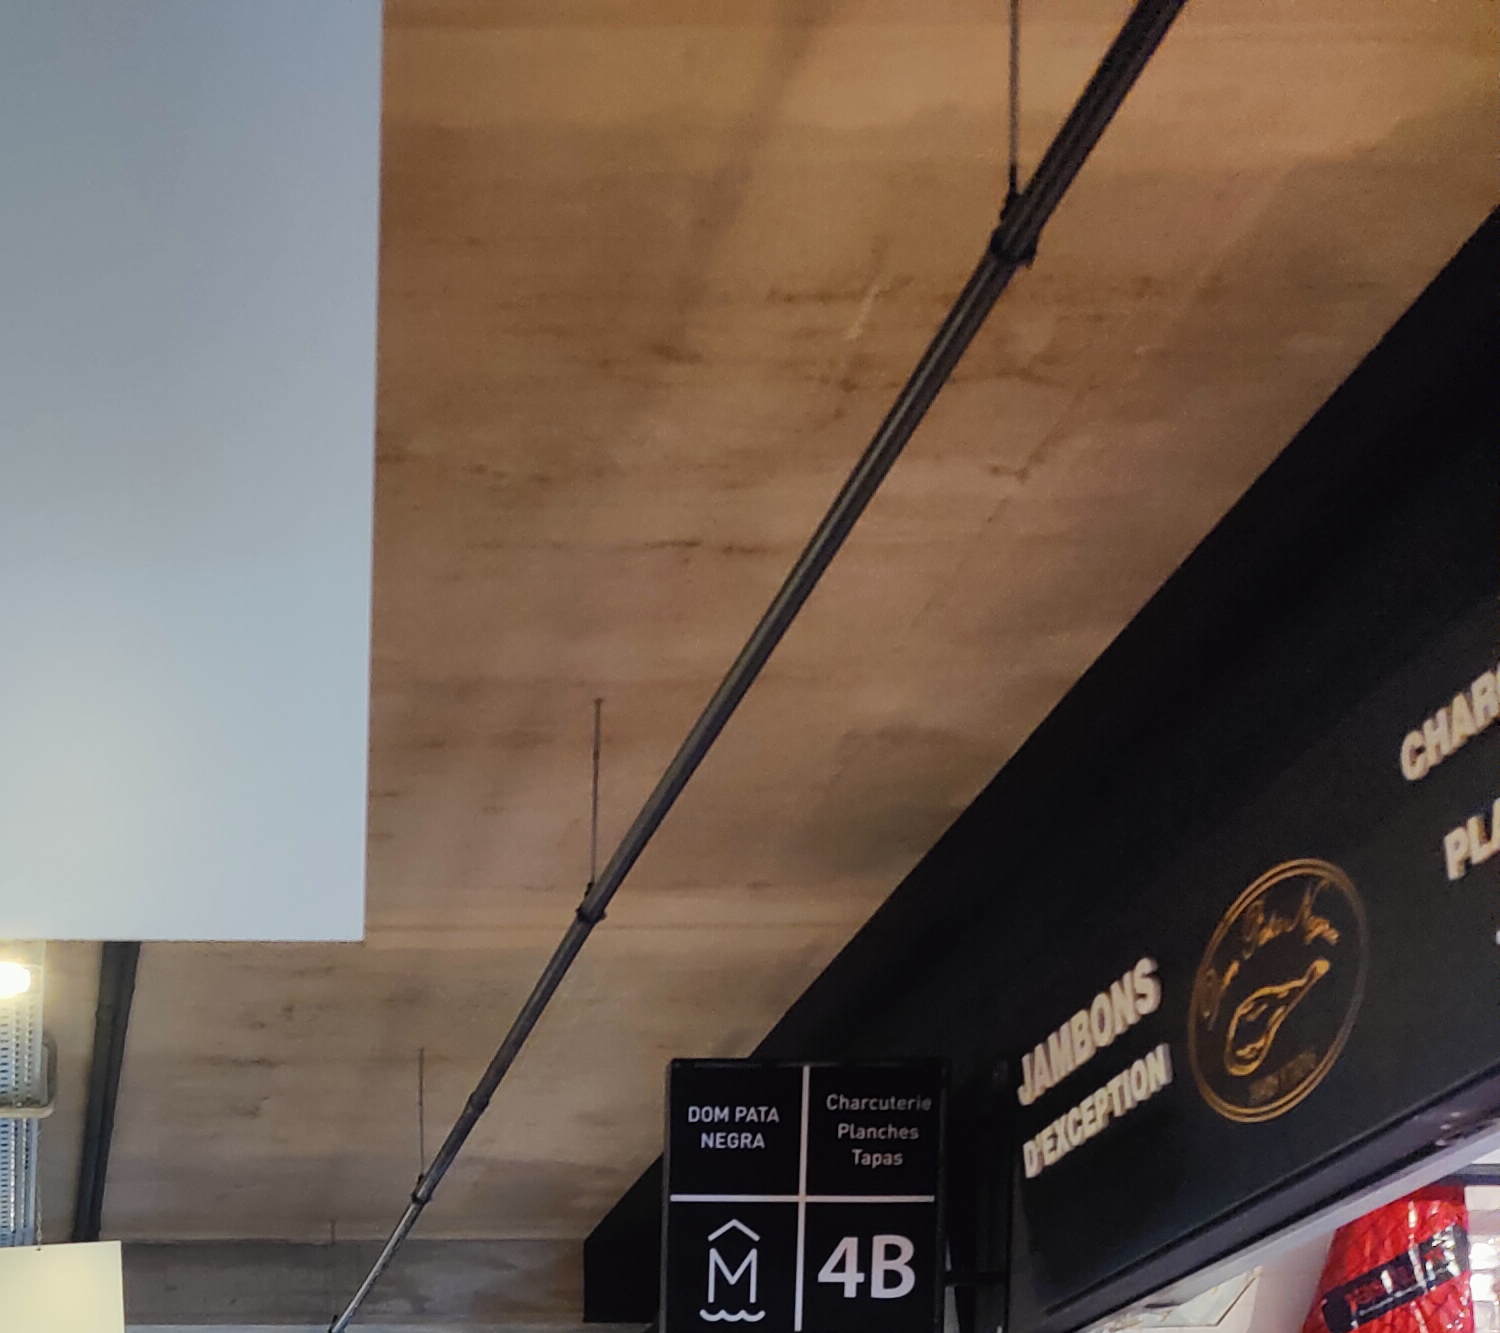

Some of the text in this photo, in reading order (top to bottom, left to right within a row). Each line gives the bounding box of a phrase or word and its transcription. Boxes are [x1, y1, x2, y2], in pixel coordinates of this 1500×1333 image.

[1401, 660, 1500, 781] CHAR
[1444, 797, 1500, 880] PLA
[1017, 955, 1162, 1105] JAMBONS
[688, 1106, 780, 1123] DOM PATA
[826, 1093, 932, 1111] Charcuterie
[1022, 1042, 1172, 1179] D'EXCEPTION
[700, 1132, 765, 1149] NEGRA
[838, 1123, 920, 1140] Planches
[852, 1149, 903, 1168] Tapas
[818, 1234, 916, 1299] 4B
